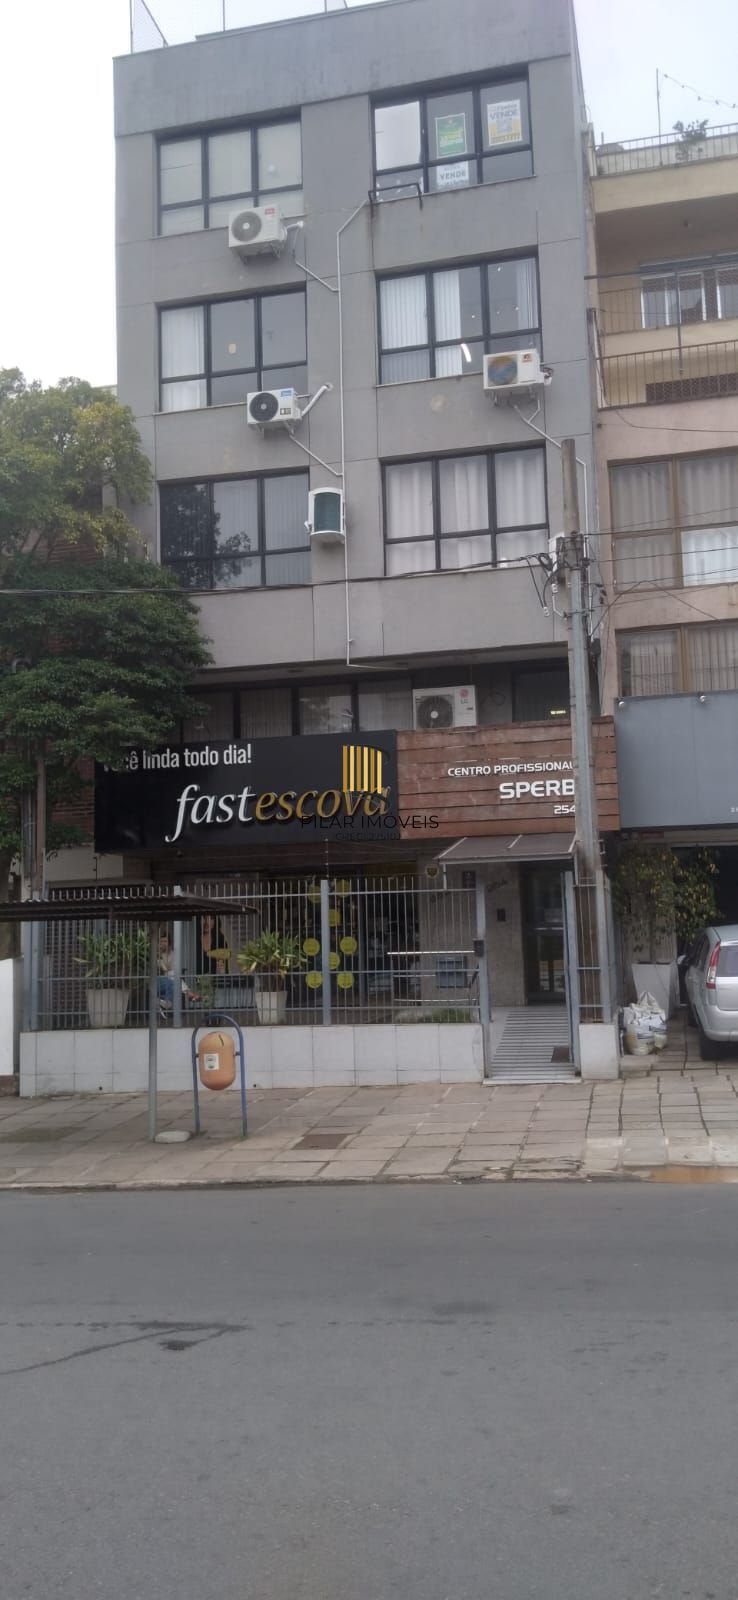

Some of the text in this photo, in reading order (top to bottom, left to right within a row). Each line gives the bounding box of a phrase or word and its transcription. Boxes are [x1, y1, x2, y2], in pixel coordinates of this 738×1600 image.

[439, 171, 466, 180] VENDE
[142, 748, 180, 770] linda
[183, 747, 219, 766] todo
[224, 744, 252, 764] dia!
[448, 766, 490, 776] CENTRO
[499, 779, 575, 799] SPERB
[165, 784, 391, 842] fastescova
